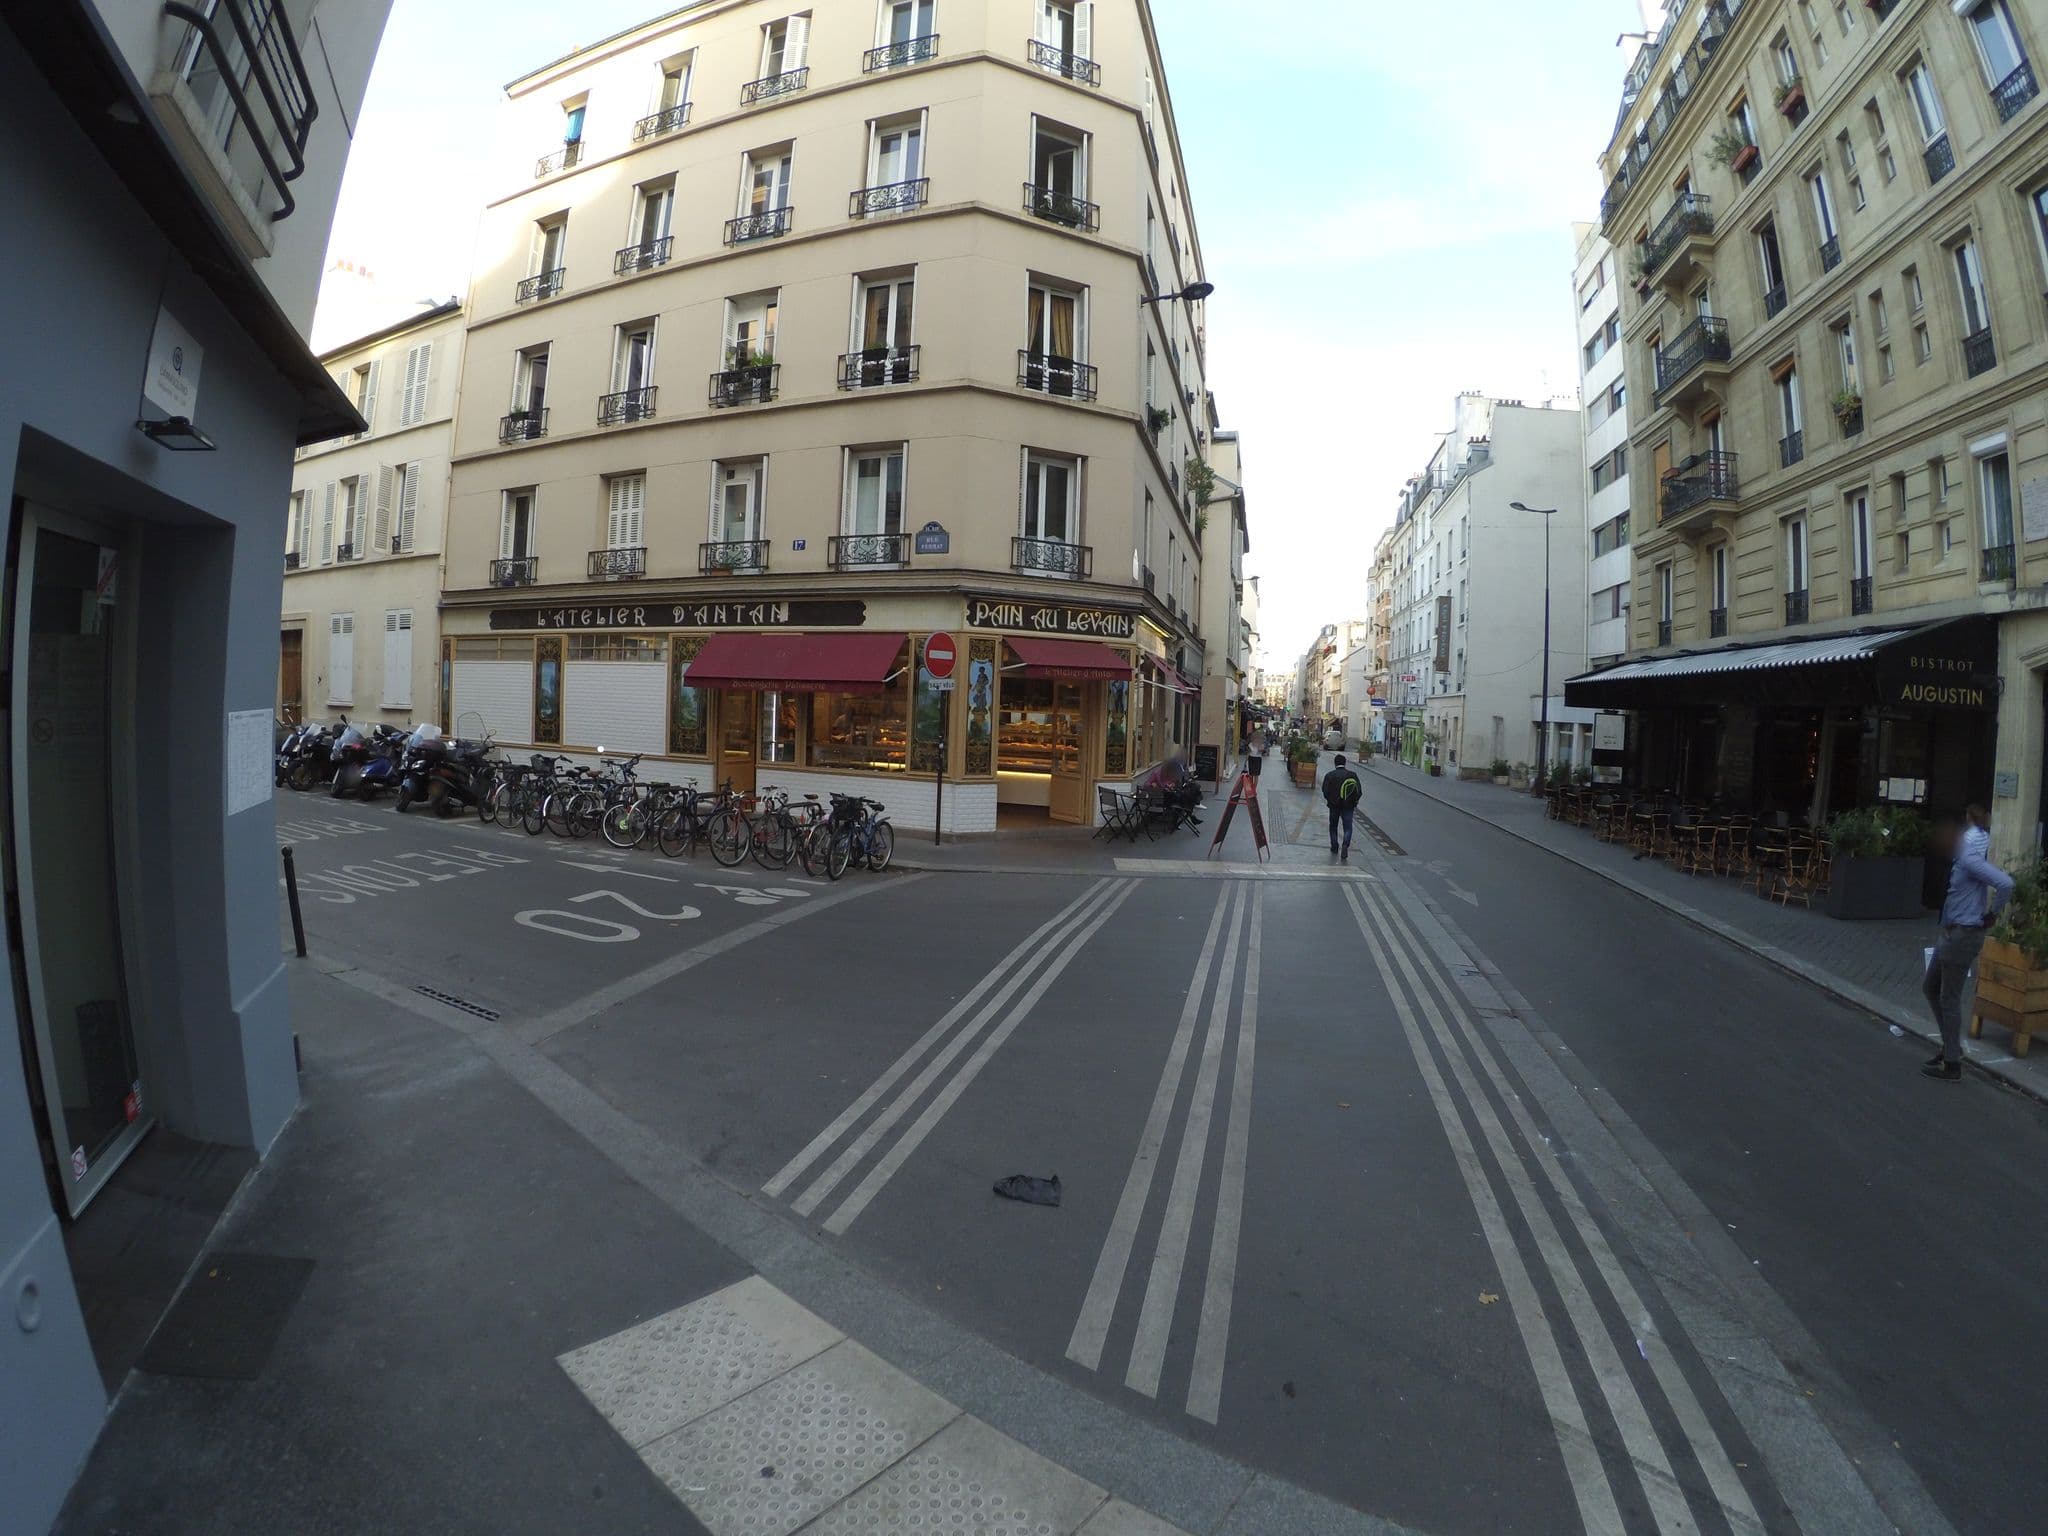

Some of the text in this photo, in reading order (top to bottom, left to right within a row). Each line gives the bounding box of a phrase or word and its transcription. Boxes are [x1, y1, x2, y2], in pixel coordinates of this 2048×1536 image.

[537, 601, 789, 627] L'ATELIER D'ANTAN
[973, 602, 1130, 635] PAIN AU LEVAIN
[1910, 656, 1975, 672] BISTROT
[1902, 684, 1983, 705] AUGUSTIN
[279, 845, 533, 905] PIETONS
[513, 889, 703, 943] 20
